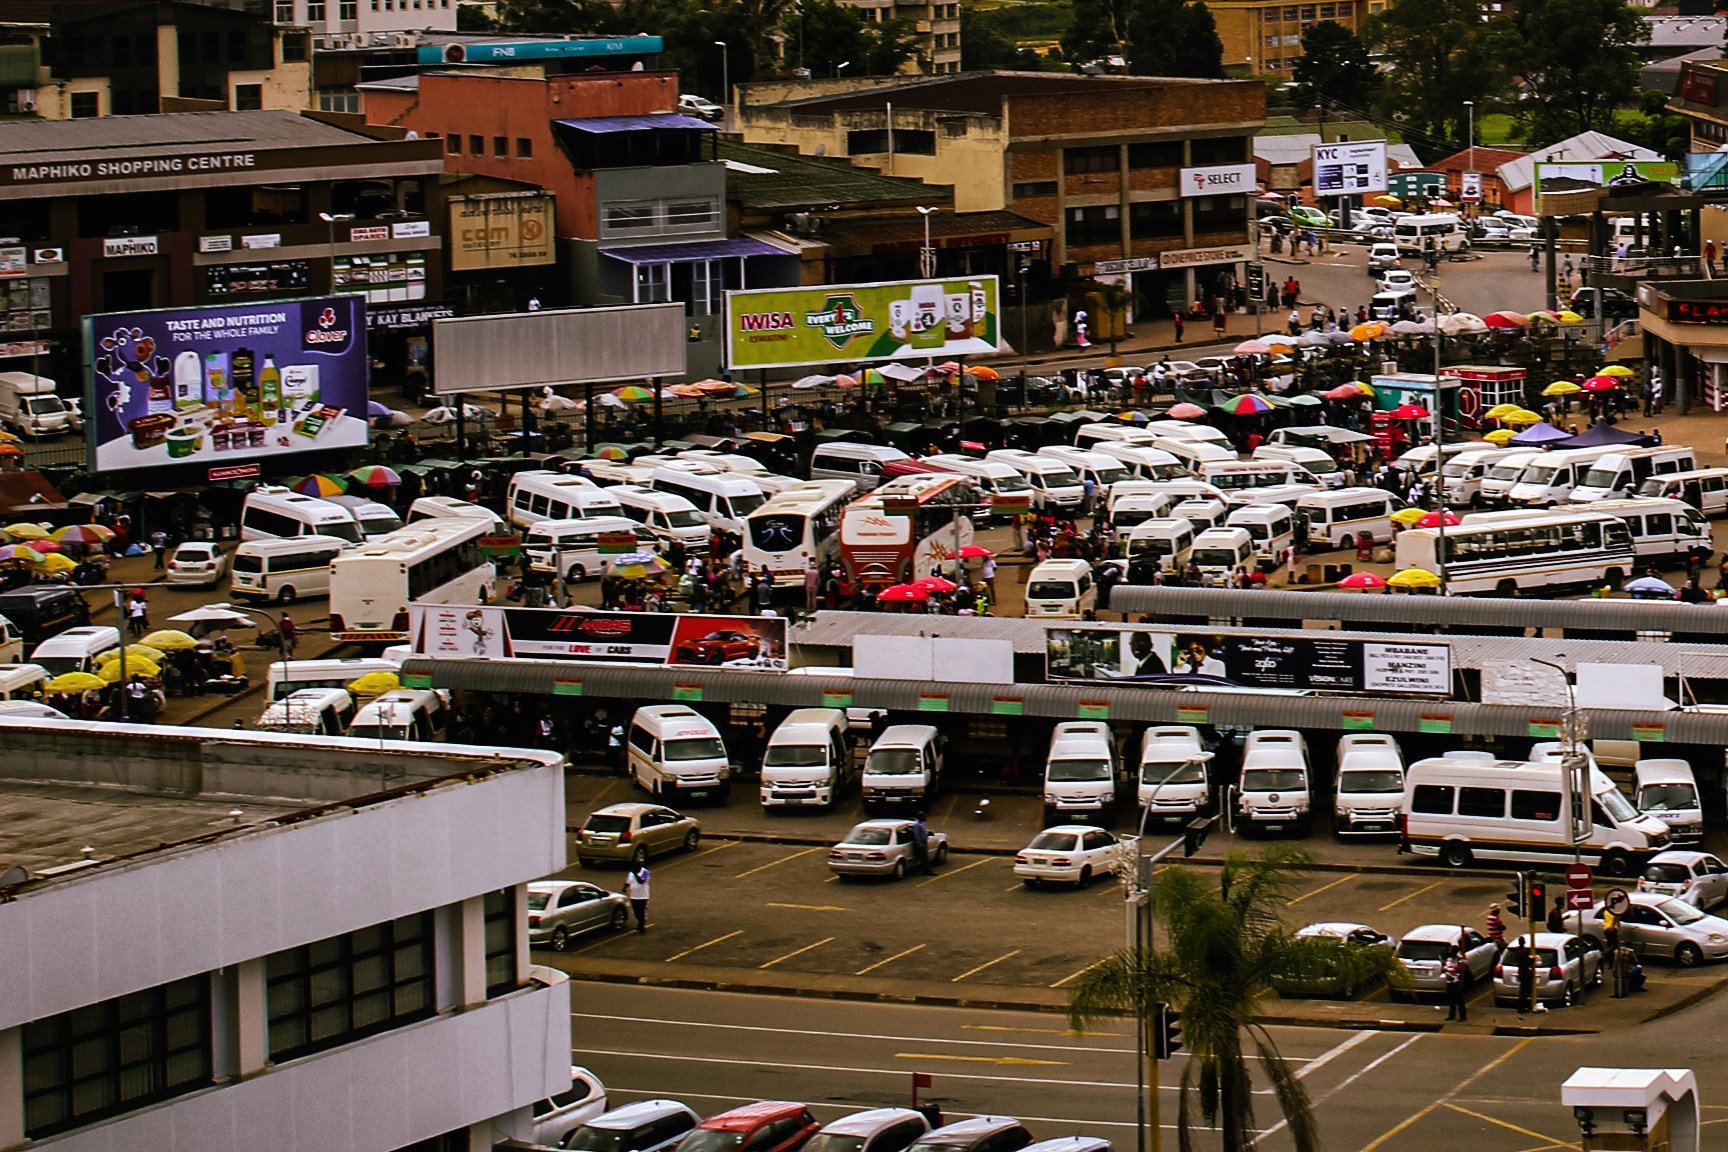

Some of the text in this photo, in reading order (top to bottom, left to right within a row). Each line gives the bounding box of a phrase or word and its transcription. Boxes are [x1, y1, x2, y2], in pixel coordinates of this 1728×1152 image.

[493, 47, 516, 57] FNB
[1316, 148, 1338, 160] KYC
[13, 154, 255, 180] MAPHIKO SHOPPING CENTRE
[1207, 172, 1242, 185] SELECT
[105, 242, 157, 256] MAPHIKO
[1204, 250, 1224, 261] STORE
[166, 313, 286, 331] TASTE AND NUTRITION
[740, 311, 795, 331] IWISA
[173, 325, 280, 342] FOR THE WHOLE FAMILY
[826, 321, 873, 336] WELCOME
[305, 330, 348, 344] Clover
[569, 645, 592, 654] LOVE
[606, 646, 632, 654] CARS
